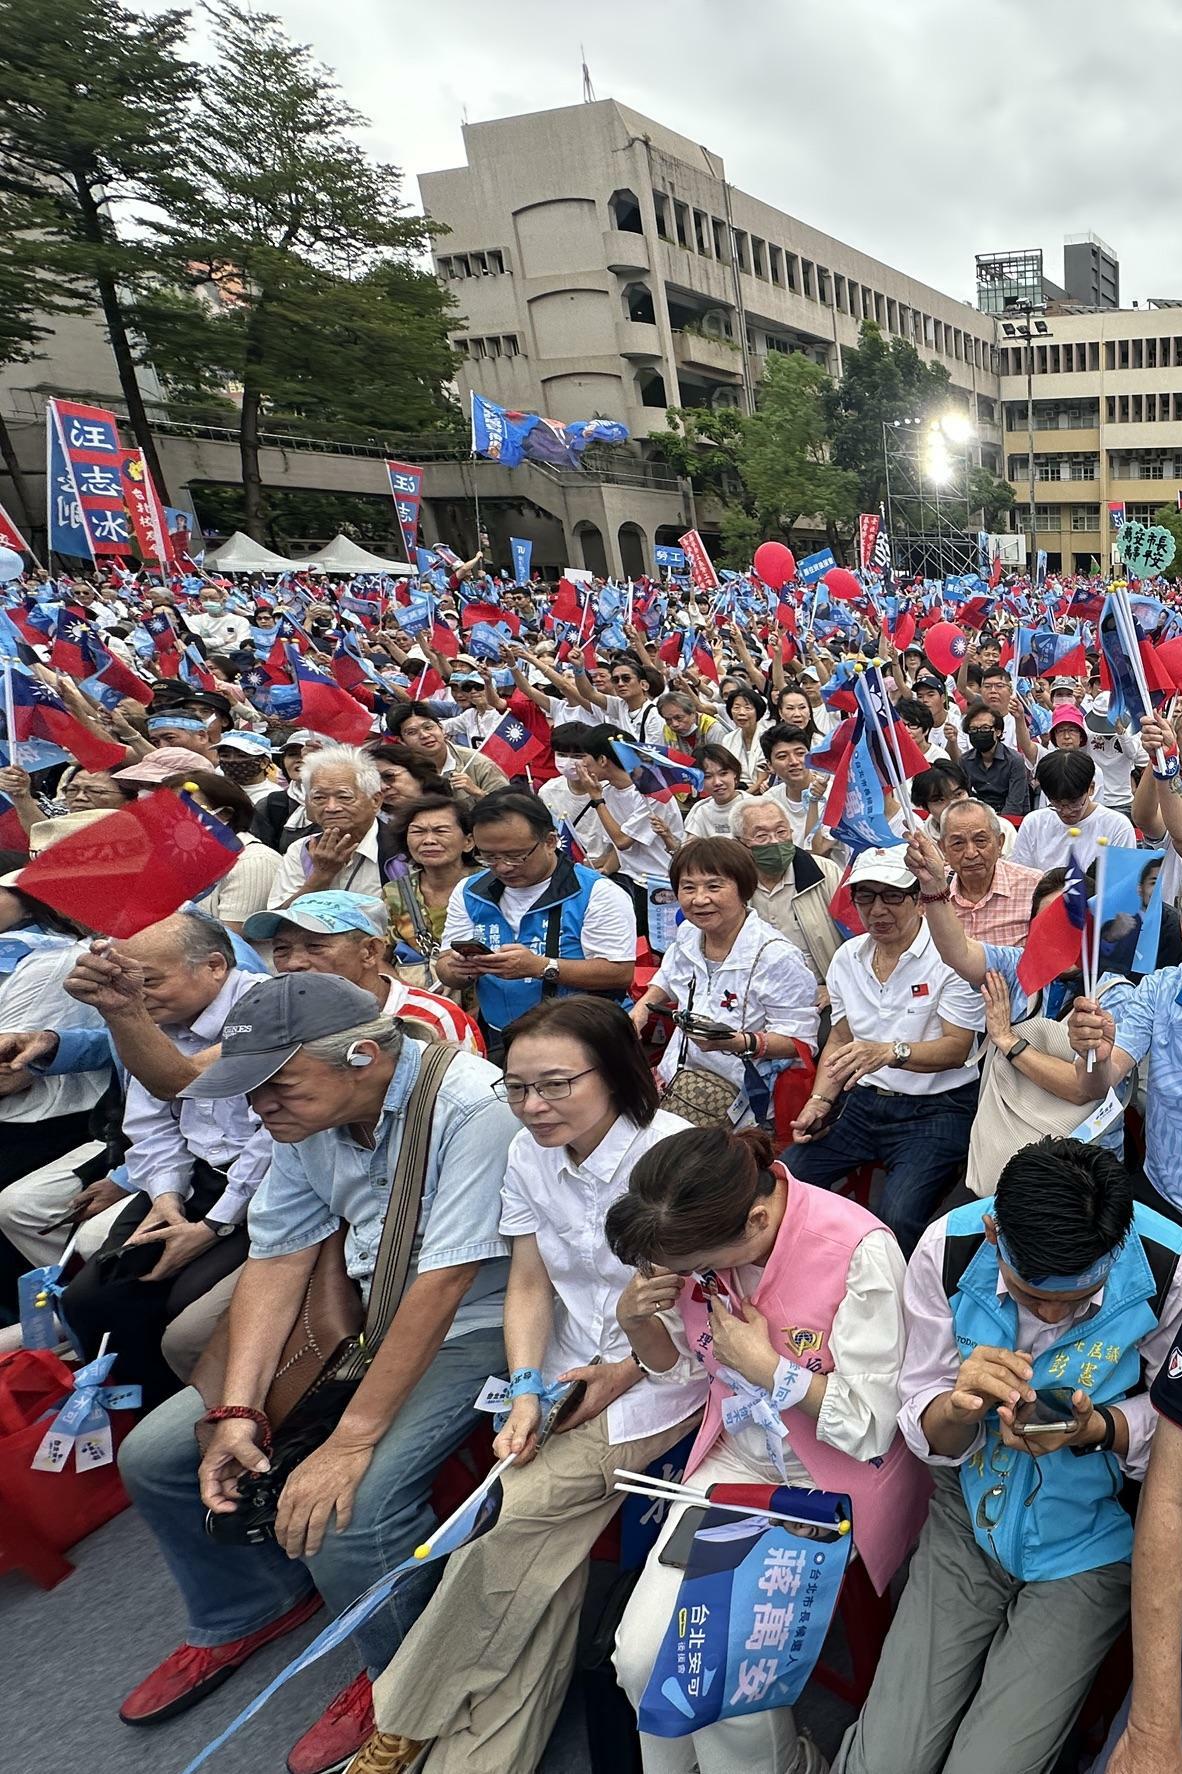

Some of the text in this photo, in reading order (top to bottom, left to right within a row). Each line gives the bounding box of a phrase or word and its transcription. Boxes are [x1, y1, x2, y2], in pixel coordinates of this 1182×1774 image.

[70, 419, 129, 542] 汪志冰
[656, 550, 681, 562] 勞工
[1122, 525, 1168, 554] 萬安市長
[687, 1604, 710, 1697] 台北安可
[729, 1547, 807, 1706] 蔣萬安
[788, 1568, 821, 1667] 台北市長候選人
